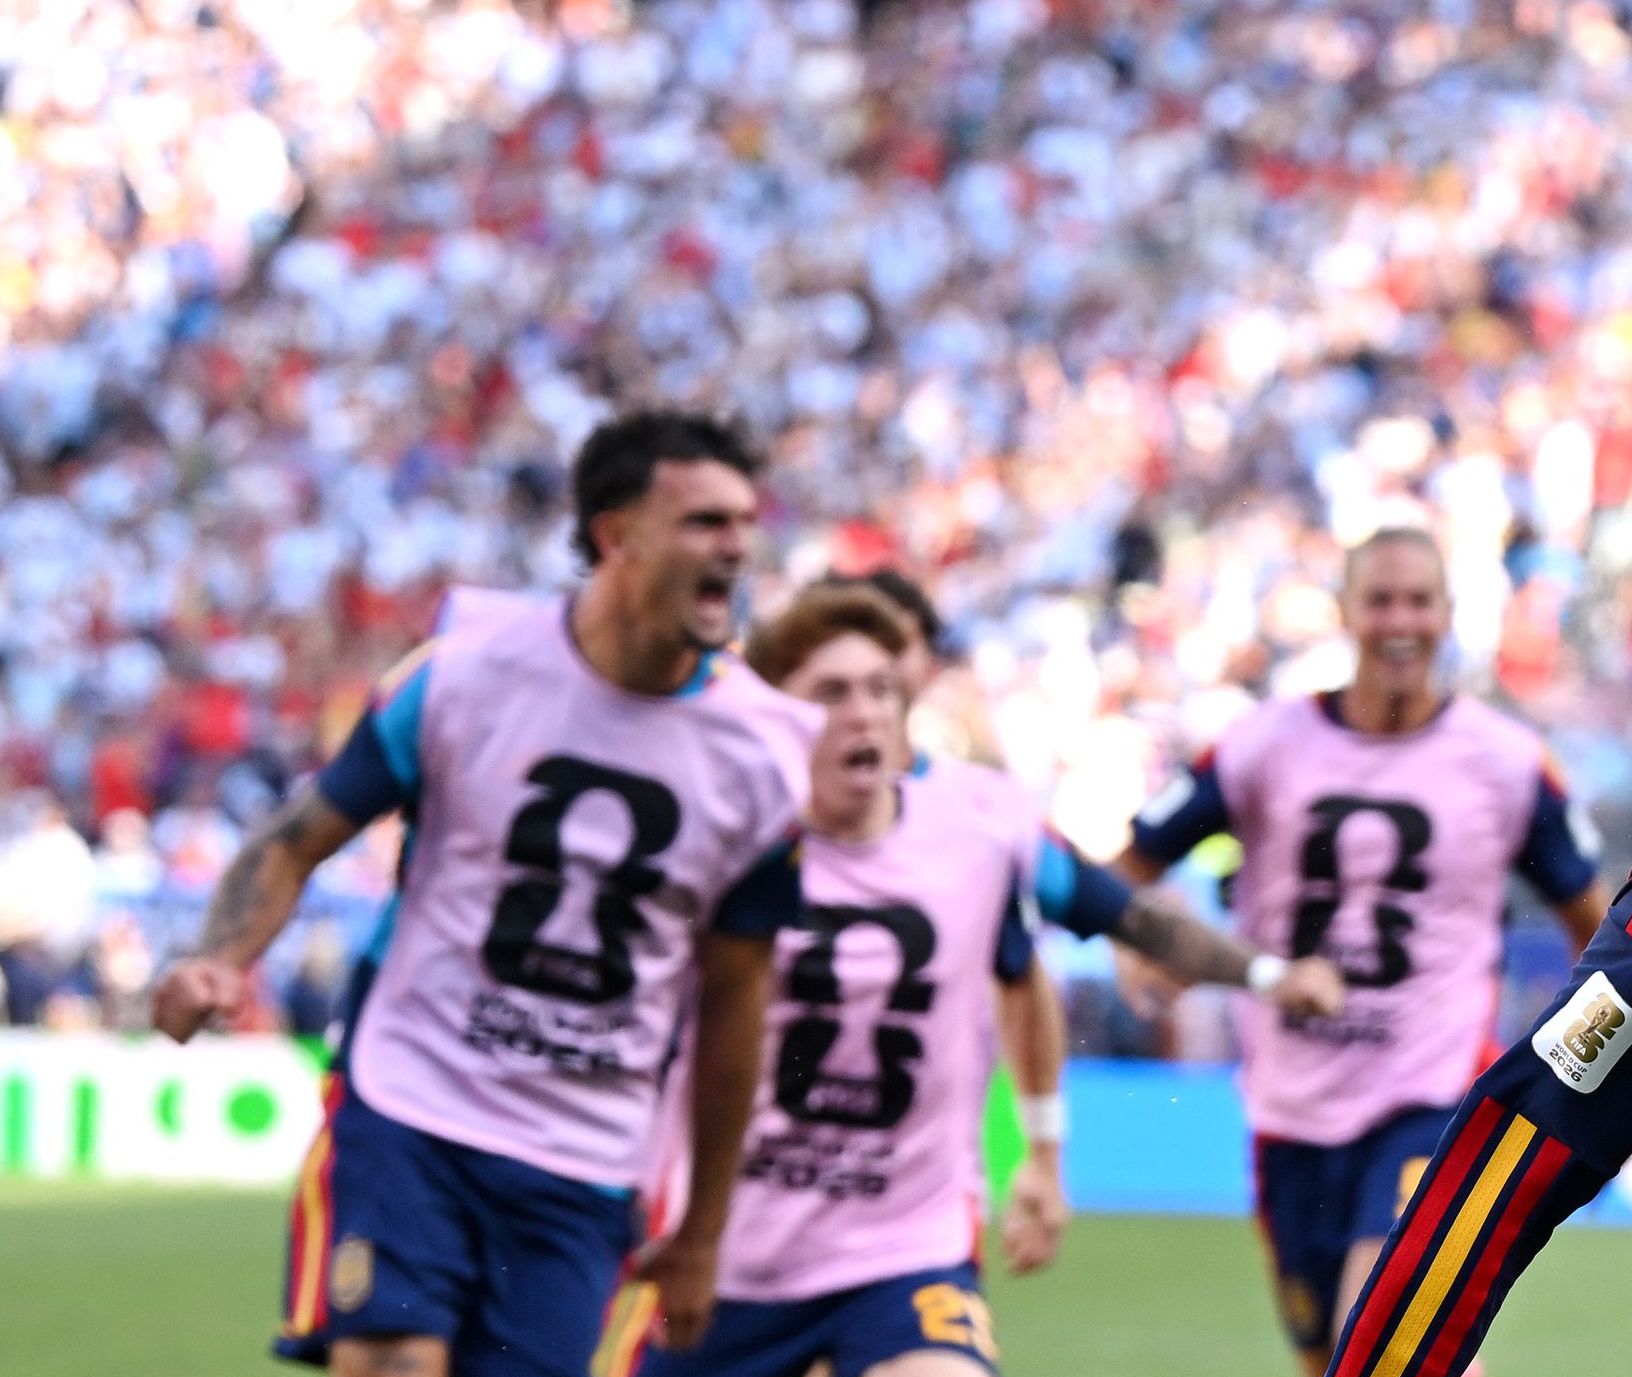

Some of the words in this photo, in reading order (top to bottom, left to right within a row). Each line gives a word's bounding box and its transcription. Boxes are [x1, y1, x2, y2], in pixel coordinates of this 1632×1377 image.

[1554, 1042, 1574, 1063] WORLD
[1573, 1061, 1588, 1074] CUP
[1571, 1037, 1587, 1056] FIFA
[1549, 1048, 1583, 1082] 2026
